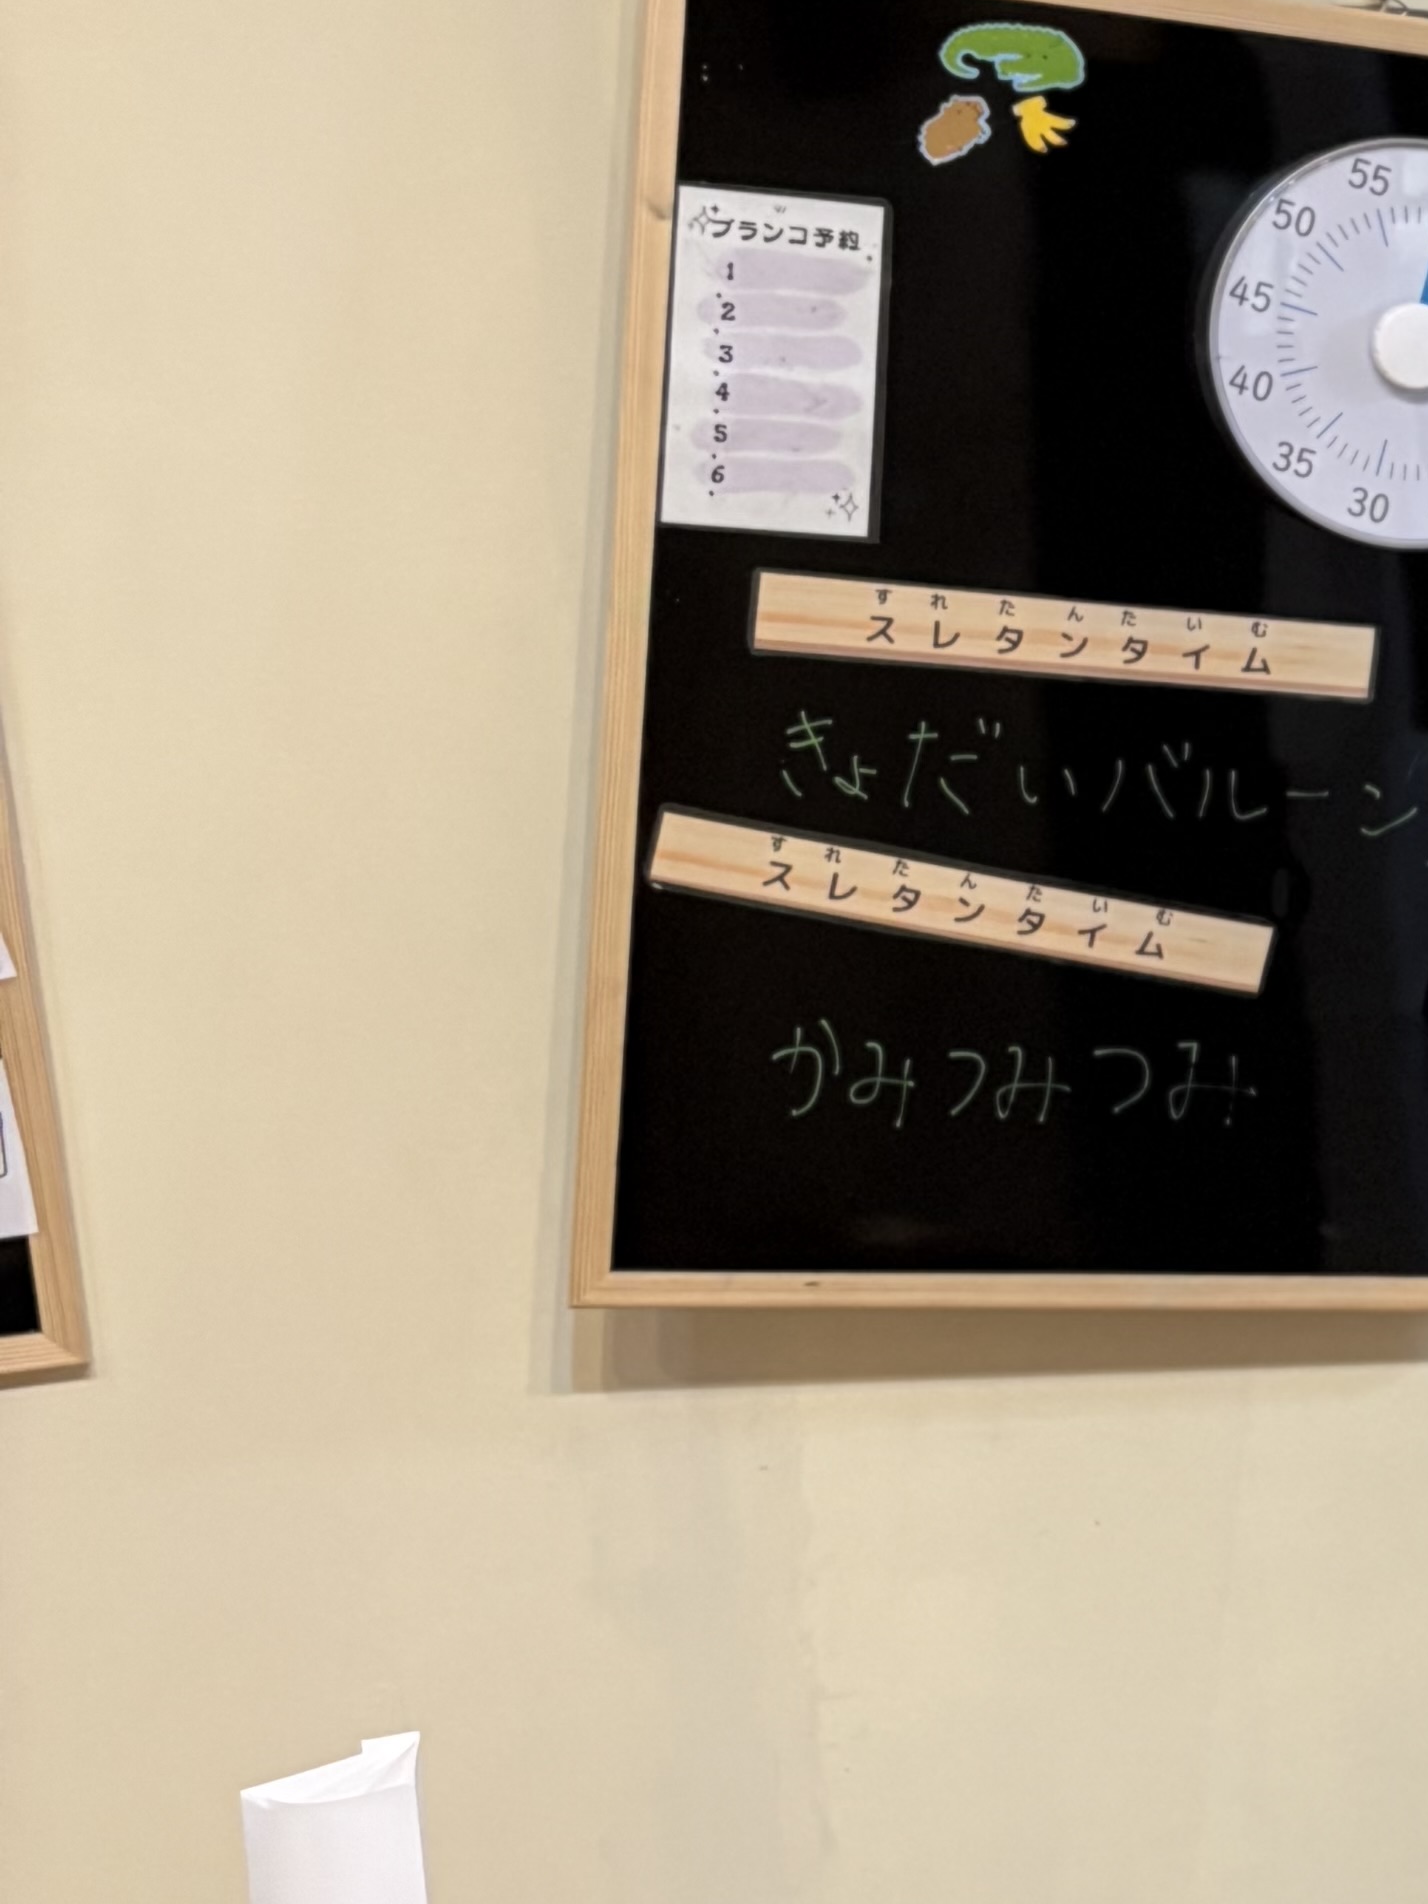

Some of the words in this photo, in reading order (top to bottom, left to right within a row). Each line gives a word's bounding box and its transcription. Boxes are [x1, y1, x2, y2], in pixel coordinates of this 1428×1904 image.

[1348, 157, 1392, 196] 55
[1271, 198, 1316, 238] 50
[1228, 276, 1274, 314] 45
[1228, 365, 1274, 402] 40
[1272, 441, 1317, 478] 35
[1347, 487, 1390, 524] 30
[866, 616, 1271, 676] スレタンタイム
[782, 711, 1419, 836] きょだいバルーン
[761, 860, 1166, 961] スレタンタイム
[771, 1018, 1257, 1127] かみつみつみ
